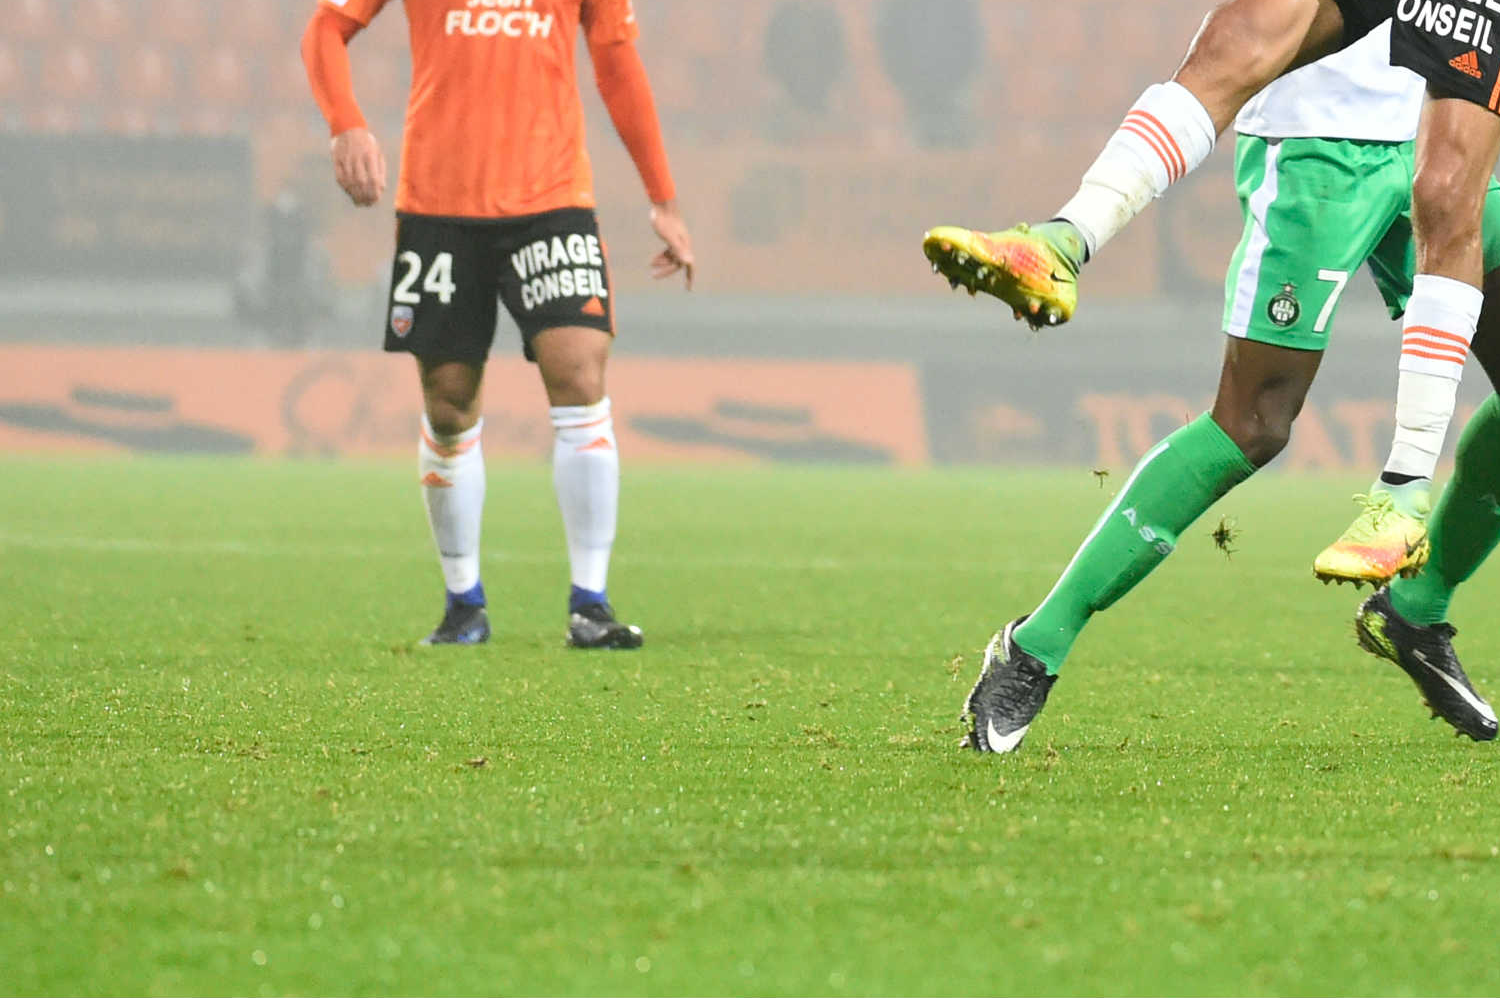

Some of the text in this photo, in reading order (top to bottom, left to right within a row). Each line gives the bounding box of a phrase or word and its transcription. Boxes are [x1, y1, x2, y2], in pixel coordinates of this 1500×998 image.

[445, 9, 553, 39] FLOC'H
[393, 250, 456, 304] 24
[511, 233, 602, 280] VIRAGE
[520, 268, 608, 310] CONSEIL
[1312, 269, 1348, 333] 7
